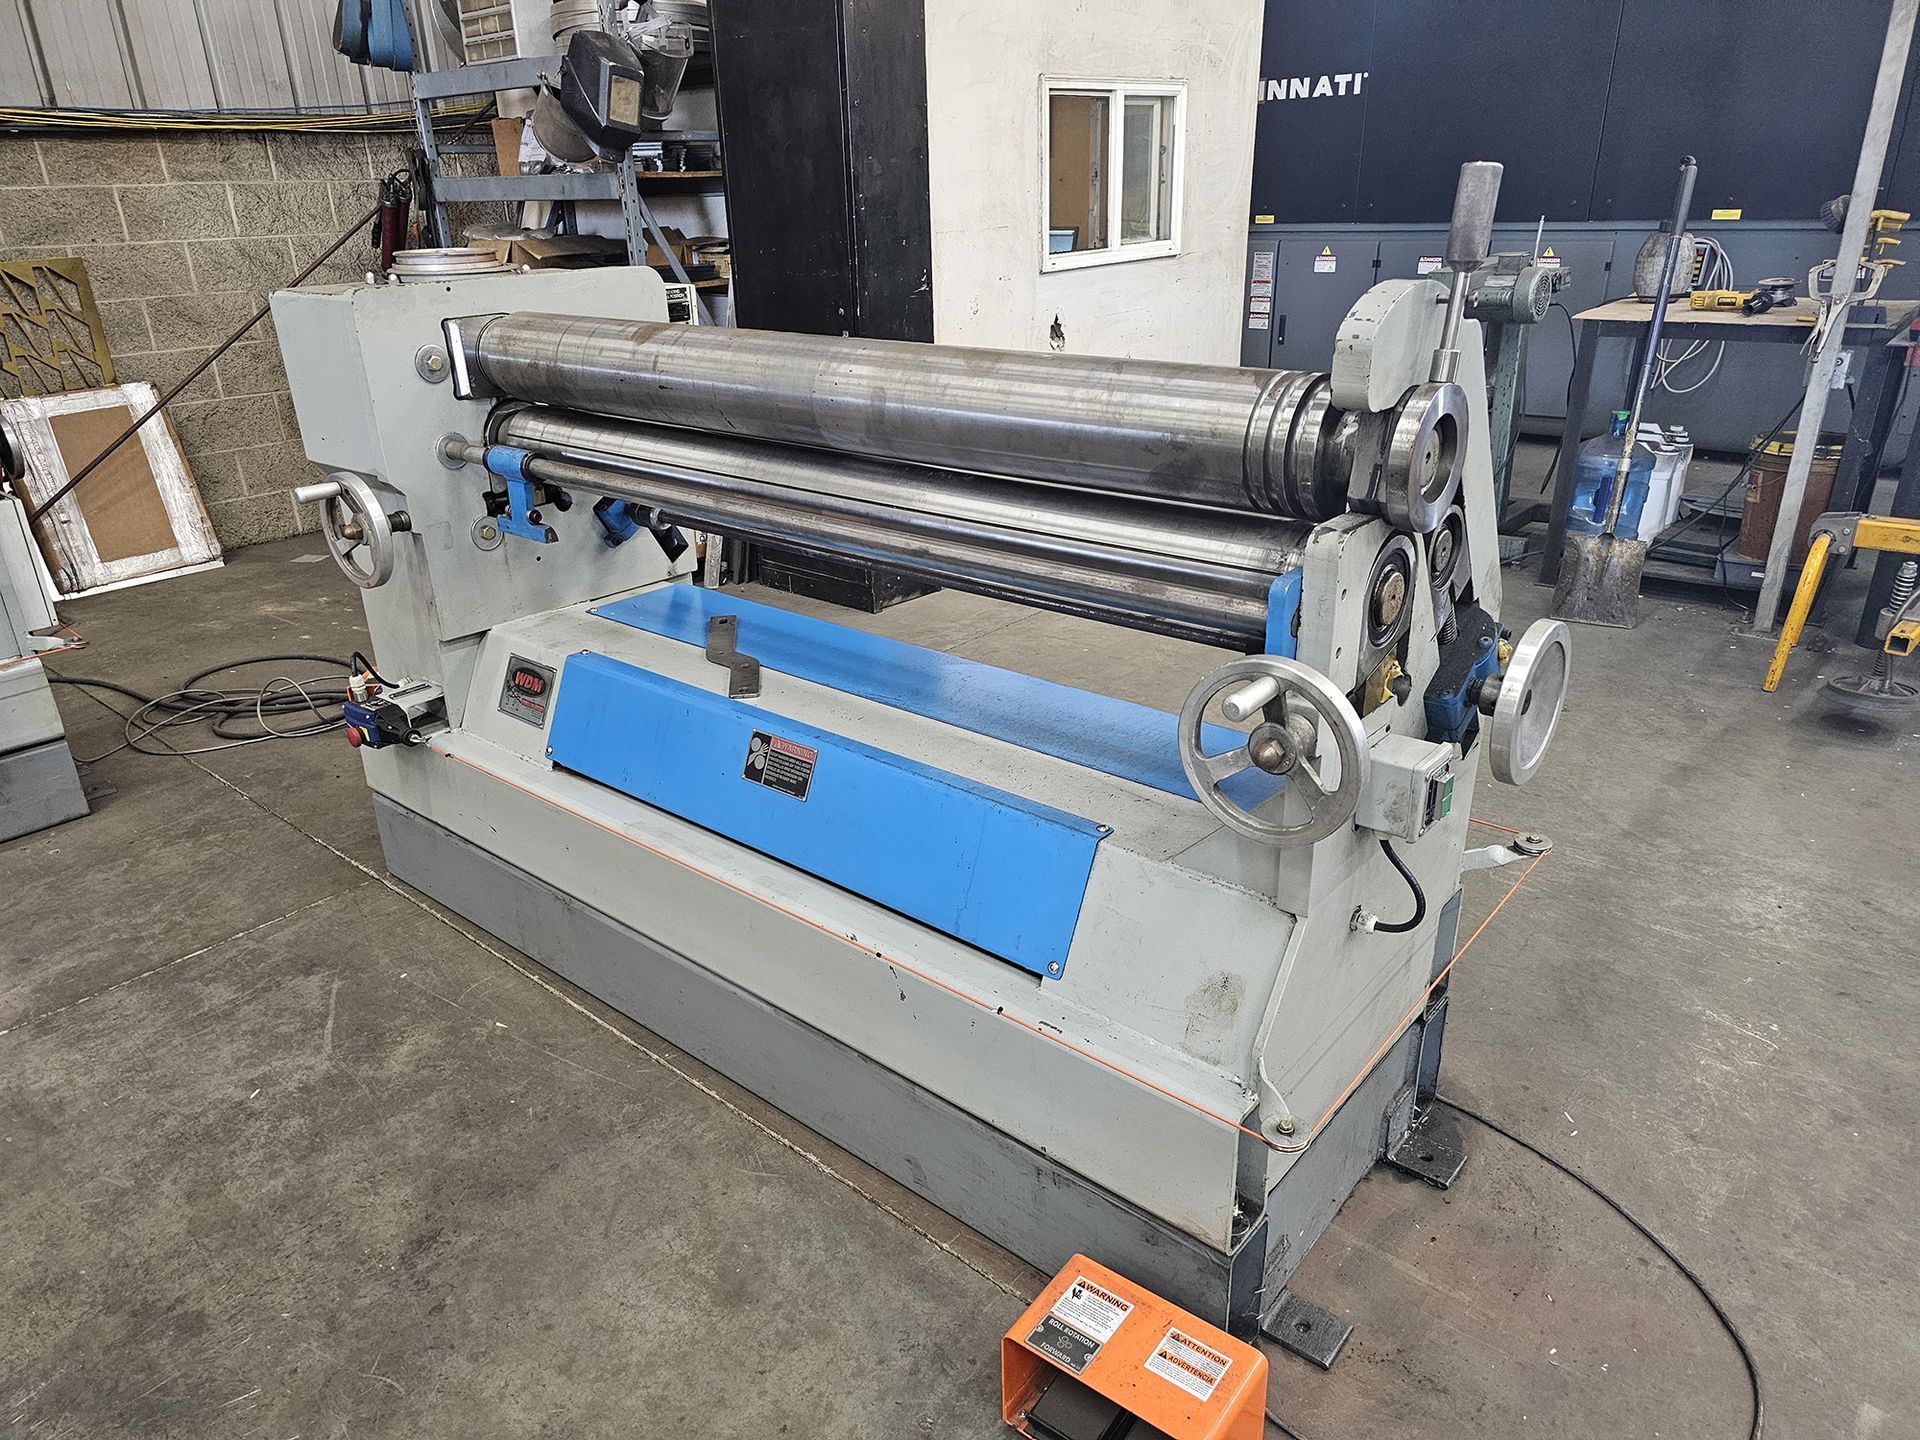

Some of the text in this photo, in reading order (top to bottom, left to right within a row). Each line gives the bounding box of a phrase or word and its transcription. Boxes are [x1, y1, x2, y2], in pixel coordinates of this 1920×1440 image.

[515, 671, 543, 692] WDM
[780, 742, 814, 760] WARNING
[1086, 1283, 1129, 1312] WARNING
[1048, 1318, 1095, 1348] ROLL ROTATION
[1040, 1342, 1071, 1363] FORWARD
[1181, 1338, 1227, 1366] ATTENTION
[1168, 1356, 1214, 1384] ADVERTENCIA
